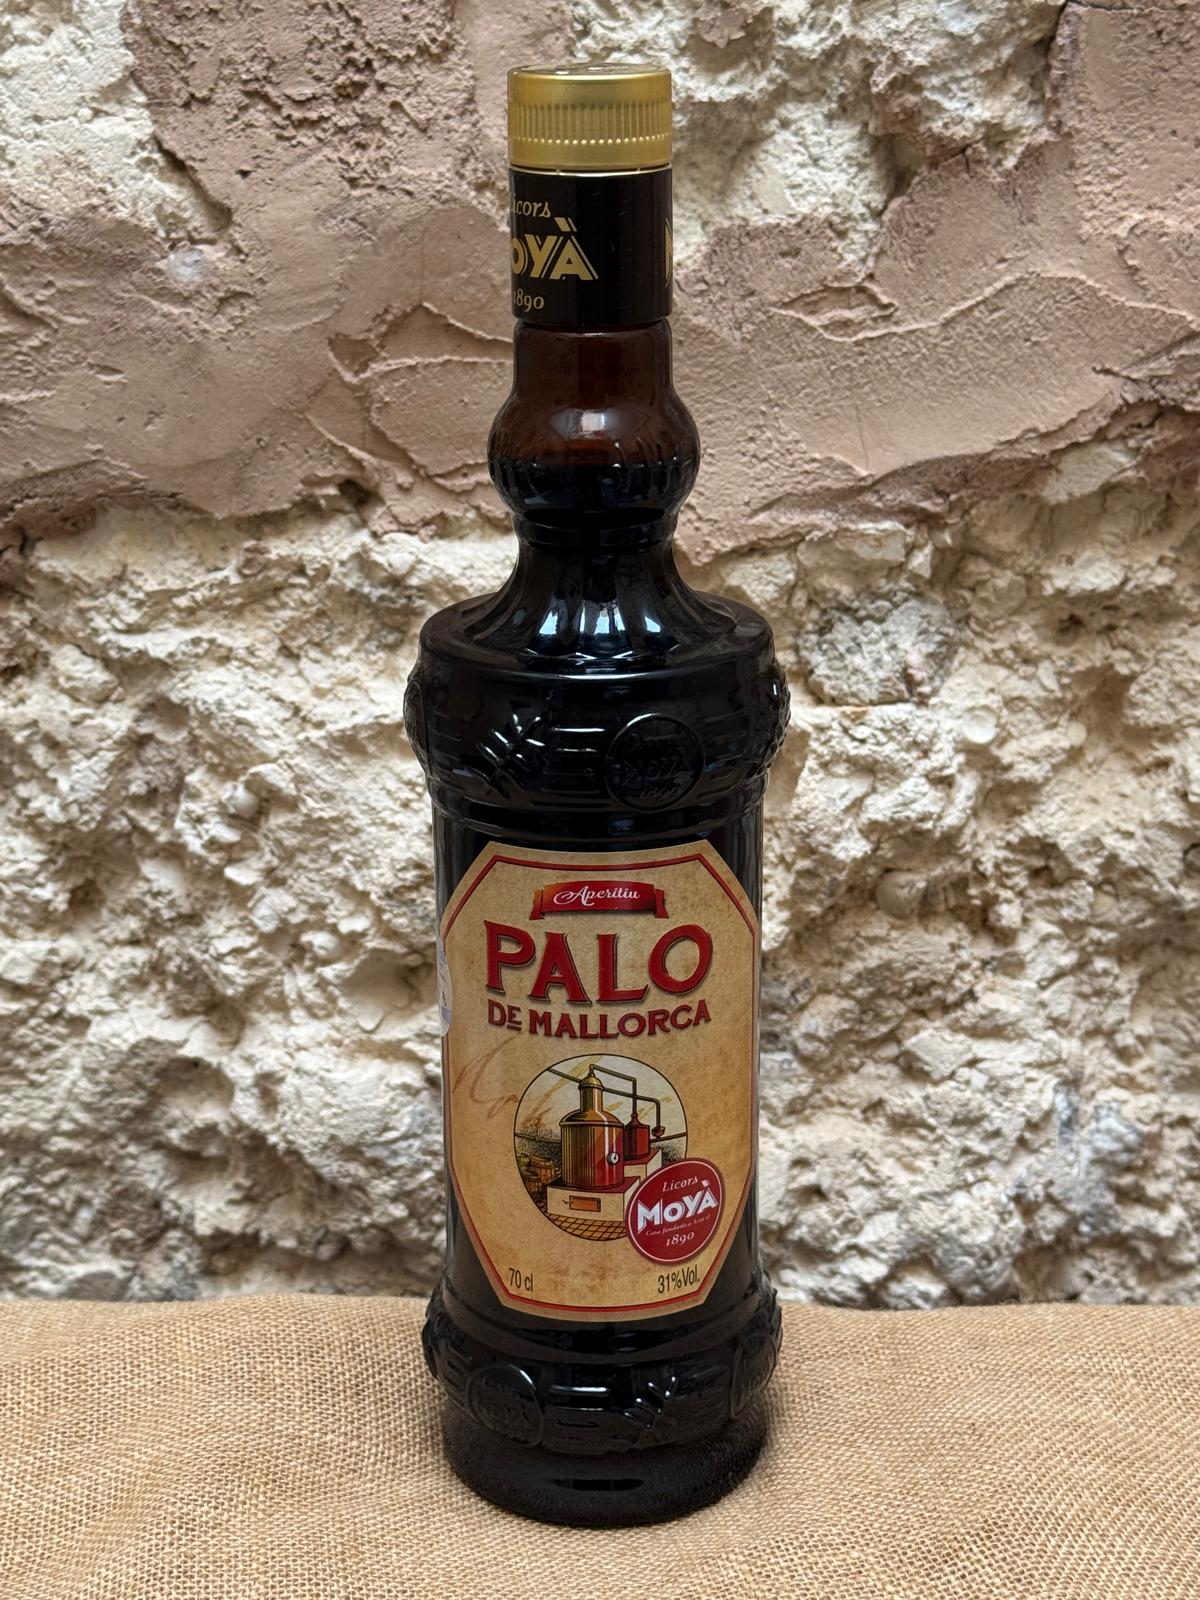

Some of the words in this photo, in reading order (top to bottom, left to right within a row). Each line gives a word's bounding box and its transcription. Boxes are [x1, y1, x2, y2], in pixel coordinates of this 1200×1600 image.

[511, 192, 551, 218] icors
[511, 216, 599, 281] OYÀ
[553, 885, 641, 906] Aperitiu
[484, 919, 714, 1003] PALO
[487, 998, 522, 1031] DE
[528, 998, 711, 1039] MALLORCA
[662, 1176, 698, 1192] Licors
[637, 1179, 719, 1233] MOYÀ
[666, 1232, 695, 1246] 1890
[508, 1267, 522, 1289] 70
[524, 1272, 534, 1293] cl
